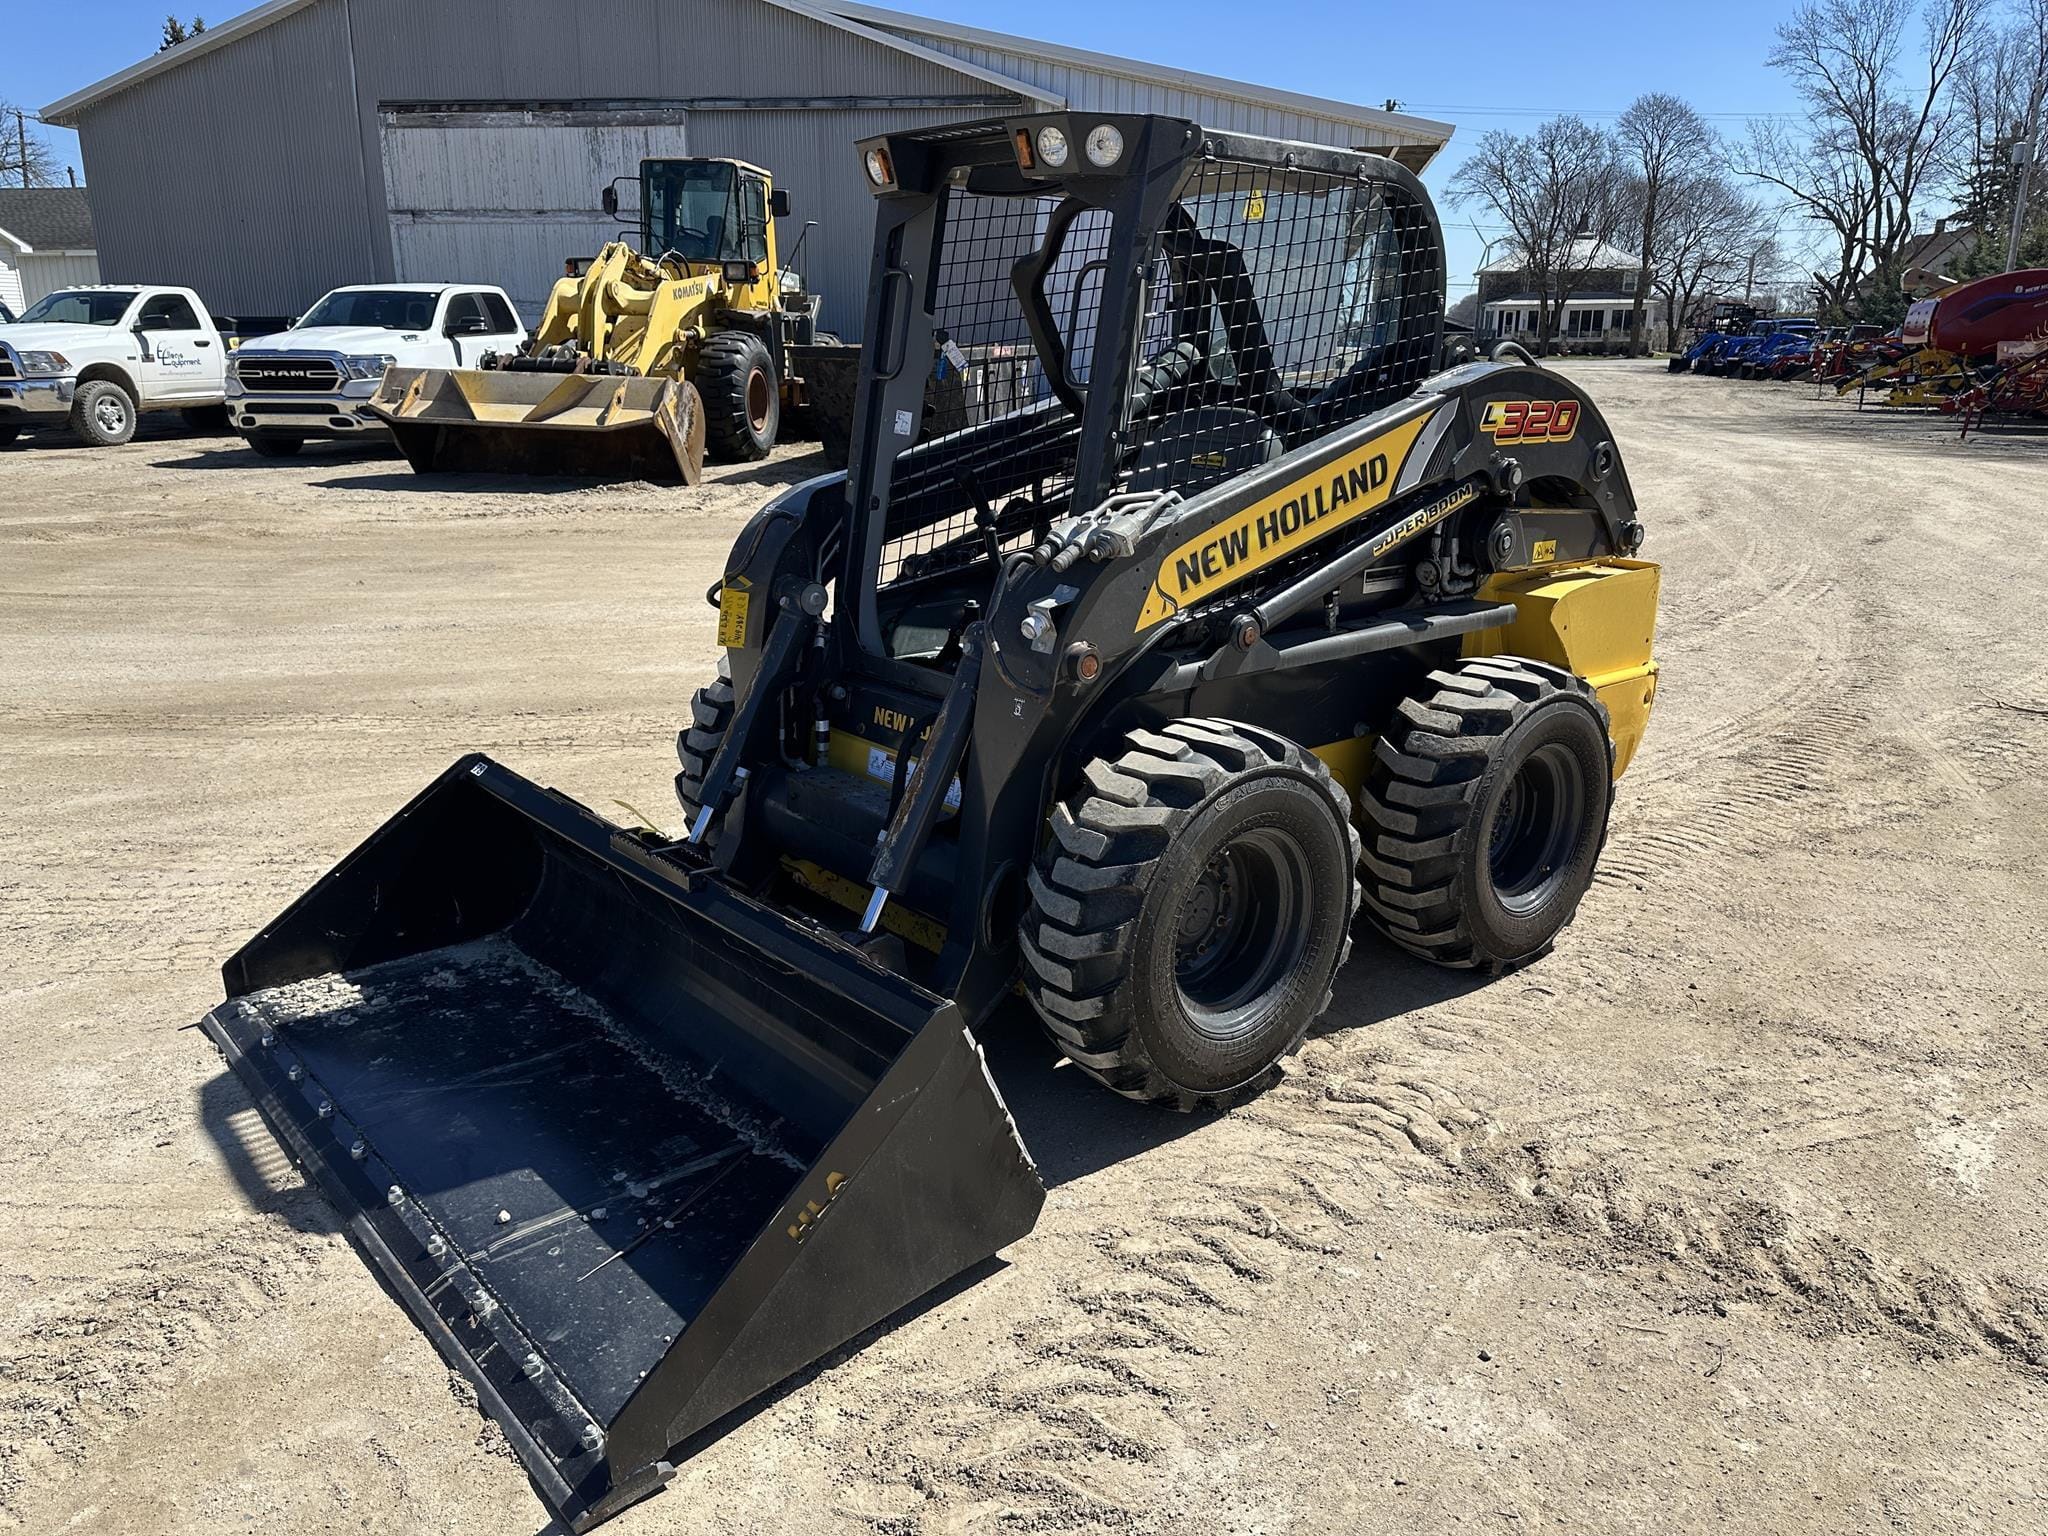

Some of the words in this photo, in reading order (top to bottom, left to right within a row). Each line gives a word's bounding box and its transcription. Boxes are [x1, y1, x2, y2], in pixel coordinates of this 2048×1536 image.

[672, 280, 704, 300] KOMATSU
[1480, 400, 1581, 446] L320
[1175, 524, 1250, 594] NEW
[1256, 452, 1389, 550] HOLLAND
[1426, 482, 1473, 523] BOOM
[874, 706, 908, 733] NEW
